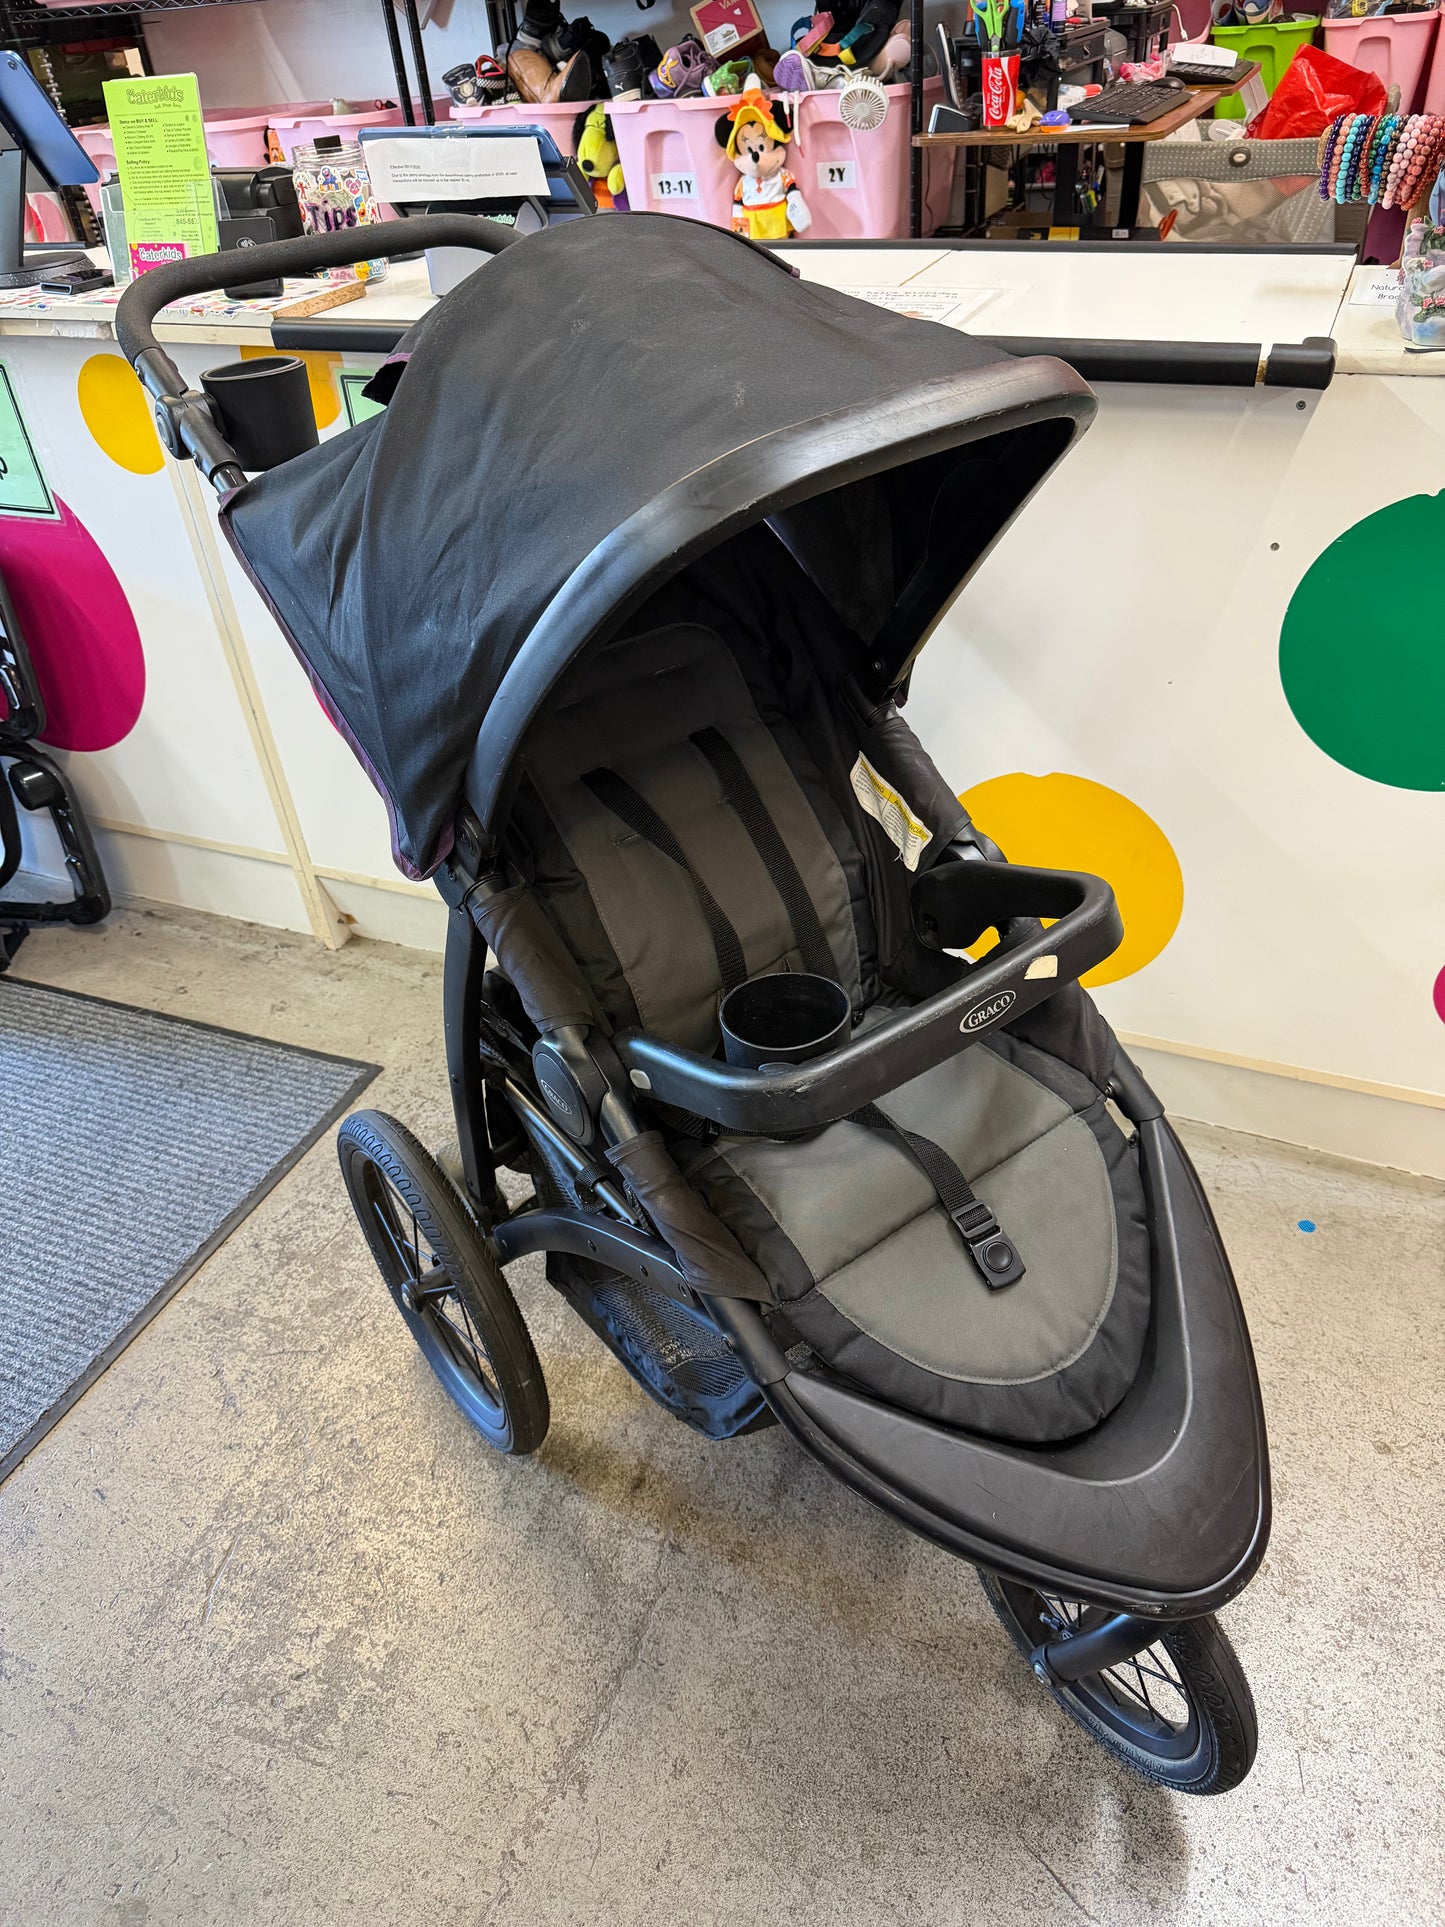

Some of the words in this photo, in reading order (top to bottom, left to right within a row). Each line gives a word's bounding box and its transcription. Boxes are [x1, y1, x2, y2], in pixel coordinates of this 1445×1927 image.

[988, 65, 1003, 120] Coca-Cola
[828, 168, 846, 182] 2Y
[658, 180, 693, 194] 13-1Y
[968, 995, 1011, 1027] GRACO
